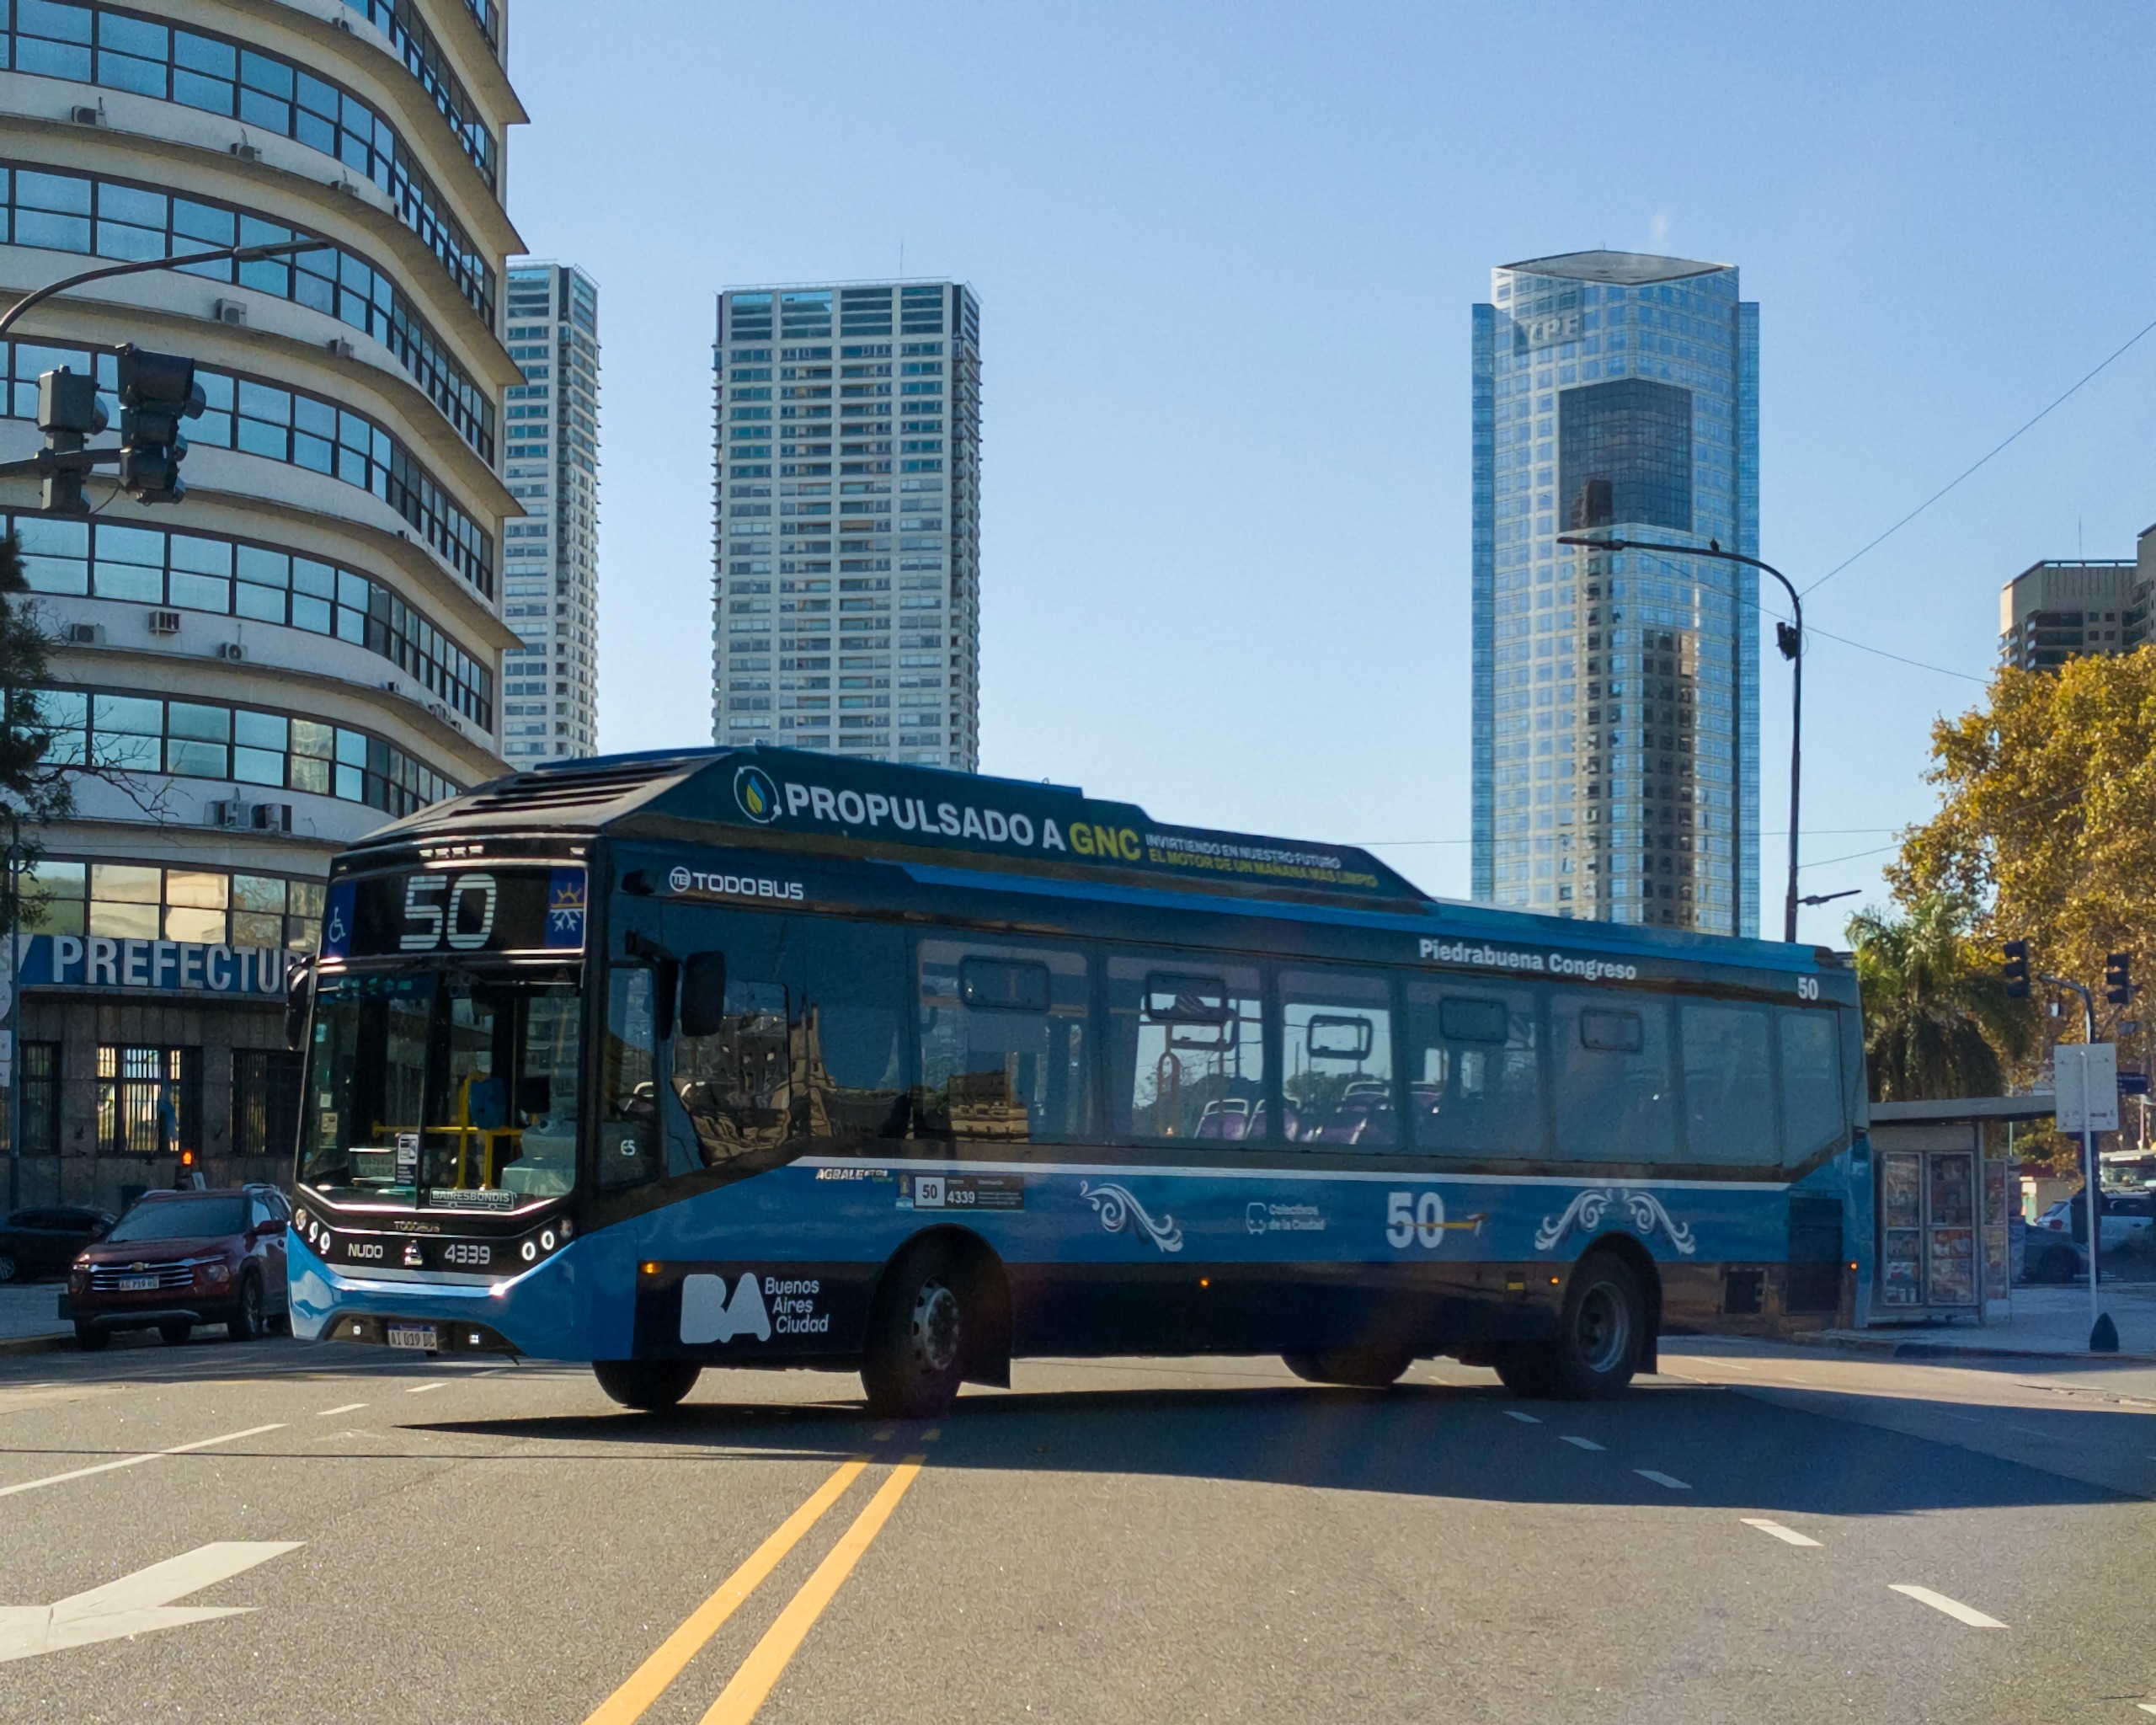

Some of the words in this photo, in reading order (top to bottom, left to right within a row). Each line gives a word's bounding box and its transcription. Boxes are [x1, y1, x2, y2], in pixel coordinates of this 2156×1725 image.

[785, 782, 1034, 846] PROPULSADO
[1043, 818, 1066, 852] A
[1069, 822, 1141, 861] GNC
[1148, 848, 1166, 863] EL
[692, 871, 804, 900] TODOBUS
[399, 873, 497, 950] 50
[1418, 938, 1544, 970] Piedrabuena
[1549, 953, 1637, 981] Congreso
[1797, 977, 1819, 1001] 50
[432, 1190, 510, 1203] BAIRESBONDIS
[922, 1183, 938, 1199] 50
[947, 1190, 975, 1204] 4339
[1385, 1192, 1444, 1248] 50
[348, 1242, 383, 1259] NUDO
[444, 1244, 491, 1264] 4339
[765, 1277, 819, 1295] Buenos
[680, 1272, 771, 1344] BA
[772, 1296, 814, 1315] Aires
[776, 1314, 830, 1333] Ciudad
